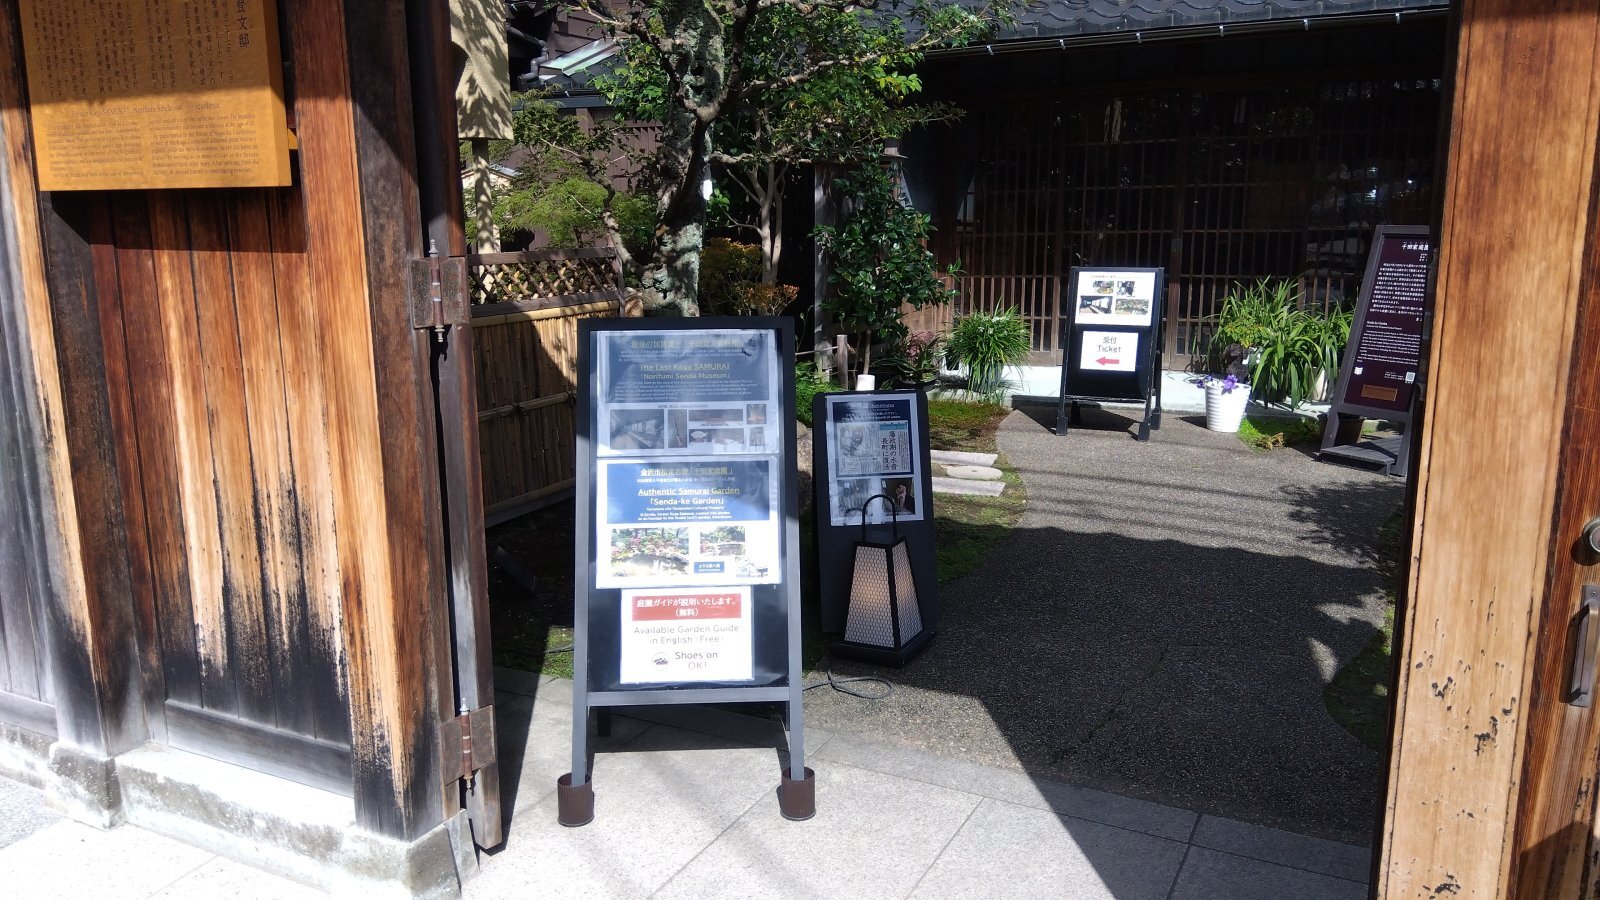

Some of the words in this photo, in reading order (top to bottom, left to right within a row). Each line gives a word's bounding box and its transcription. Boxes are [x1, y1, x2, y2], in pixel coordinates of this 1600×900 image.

[1102, 336, 1117, 344] 受付
[1097, 345, 1121, 353] Ticket
[638, 488, 676, 496] Authentic
[679, 487, 709, 495] Samurai
[711, 486, 740, 494] Garden
[636, 597, 737, 608] 庭園ガイドが説明いたします。
[634, 626, 675, 634] Available
[677, 625, 710, 633] Garden
[713, 624, 740, 632] Guide
[650, 636, 658, 644] in
[660, 636, 693, 645] English
[674, 651, 704, 659] Shoes
[688, 661, 707, 670] OK!
